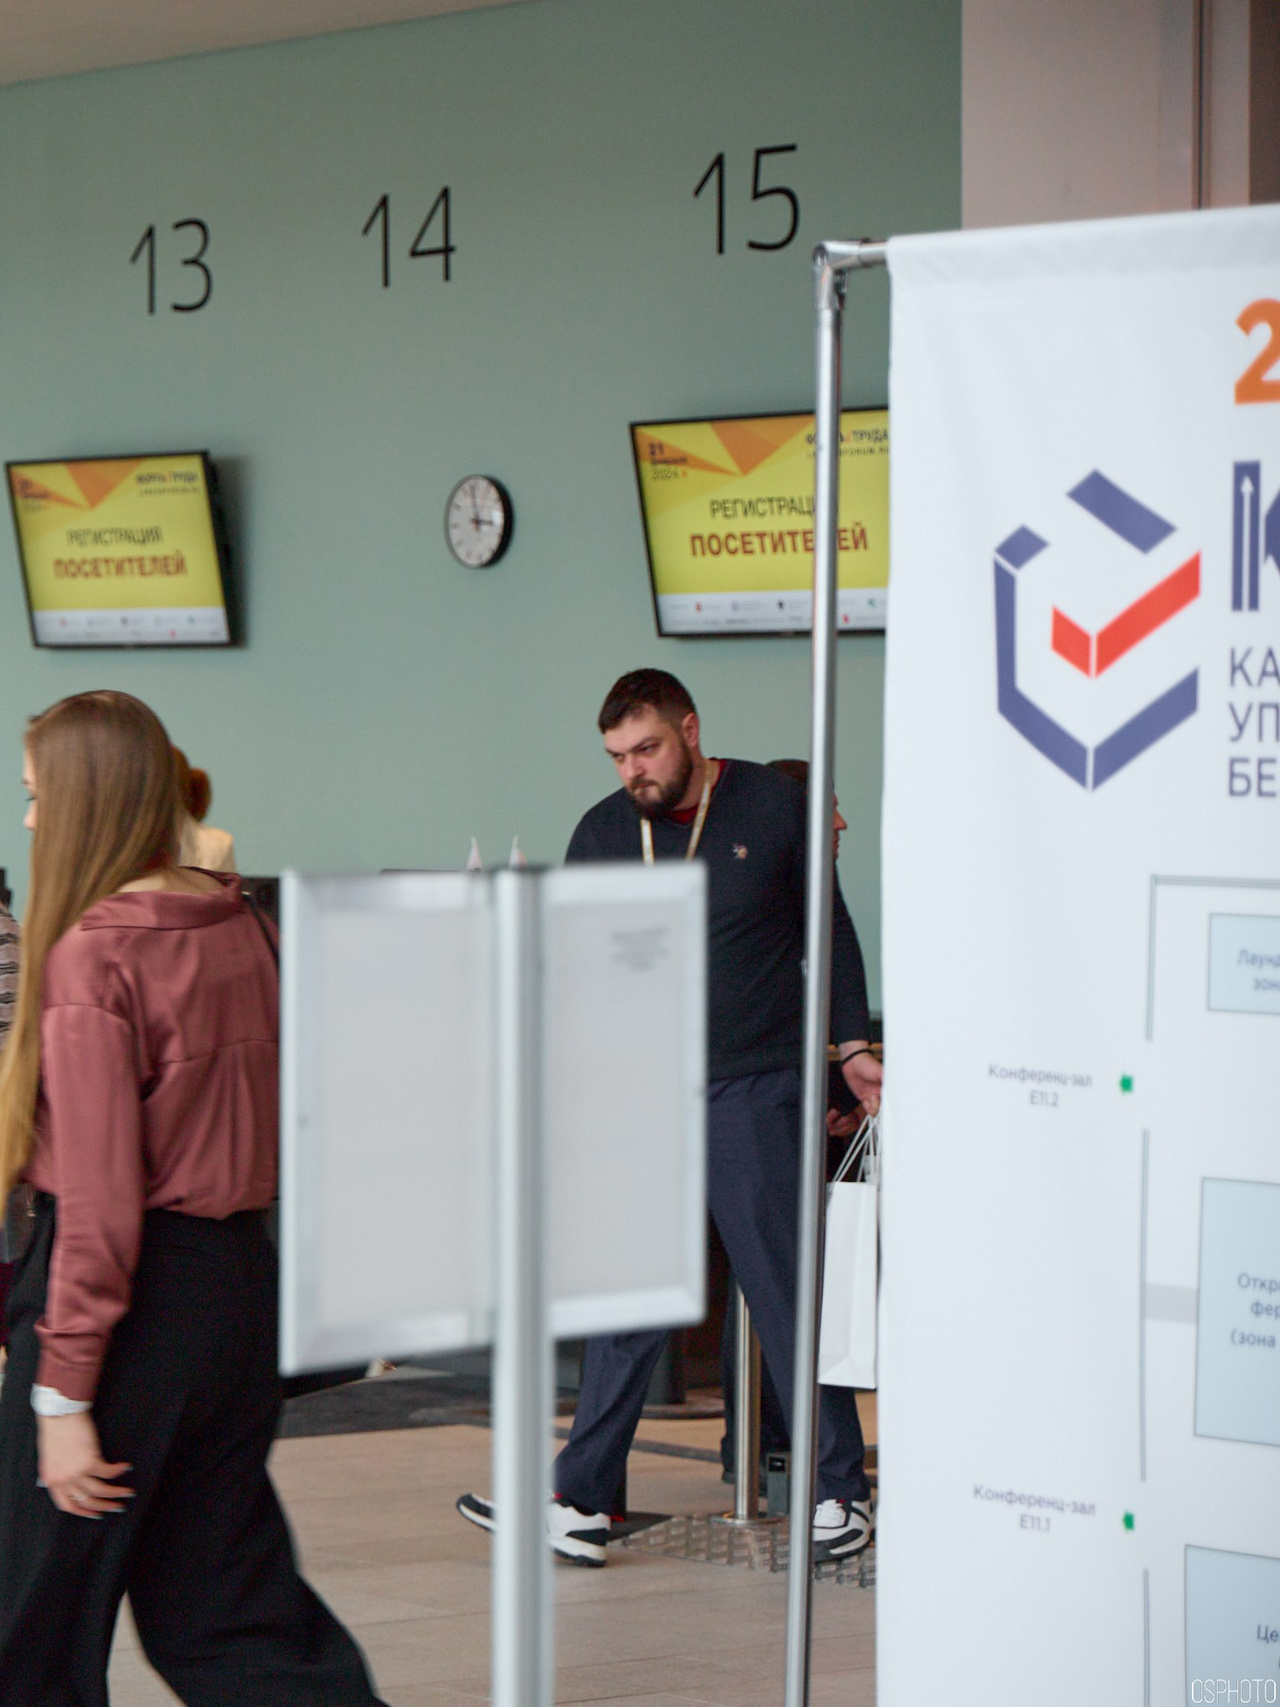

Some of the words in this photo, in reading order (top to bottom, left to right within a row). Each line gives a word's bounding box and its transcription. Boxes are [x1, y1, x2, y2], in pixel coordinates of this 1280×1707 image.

[693, 143, 799, 254] 15
[362, 185, 455, 288] 14
[130, 217, 213, 315] 13
[690, 521, 869, 556] ПОСЕТИТЕЕЙ
[54, 552, 187, 580] ПОСЕТИТЕЛЕЙ
[988, 1064, 1093, 1087] Конференц-зал
[1231, 1328, 1276, 1348] (зона
[973, 1484, 1096, 1515] Конференц-зал
